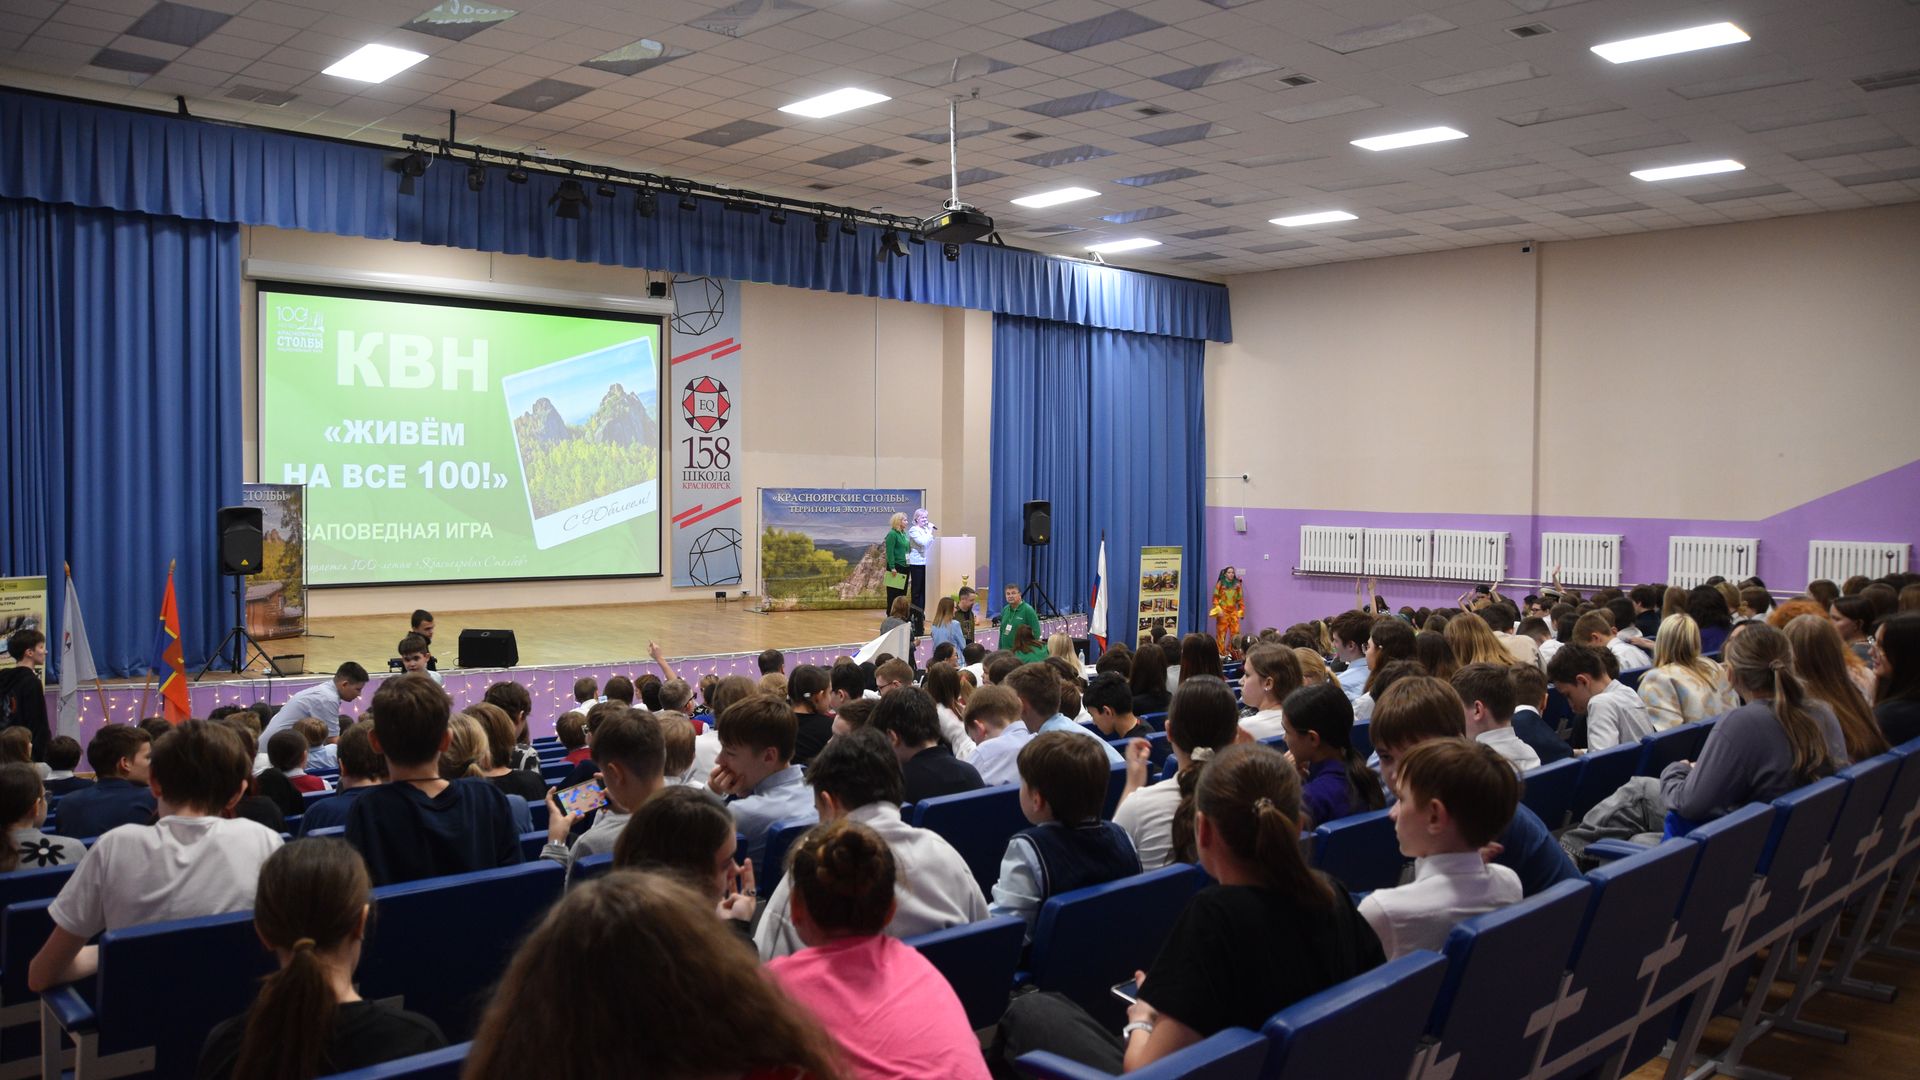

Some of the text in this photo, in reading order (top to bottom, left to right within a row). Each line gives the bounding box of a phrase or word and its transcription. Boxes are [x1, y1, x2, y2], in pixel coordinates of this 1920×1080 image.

[277, 335, 323, 349] СТОЛБЫ
[336, 330, 488, 392] КВН
[699, 399, 715, 412] EQ
[323, 417, 465, 446] «ЖИВЁМ
[682, 436, 731, 469] 158
[283, 460, 509, 489] НА ВСЕ 100!»
[682, 482, 731, 490] КРАСНОЯРСК
[772, 493, 909, 504] «КРАСНОЯРСКИЕ СТОЛБЫ»
[789, 505, 896, 513] ТЕРРИТОРИЯ ЭКОТУРИЗМА
[302, 522, 494, 543] ЗАПОВЕДНАЯ ИГРА
